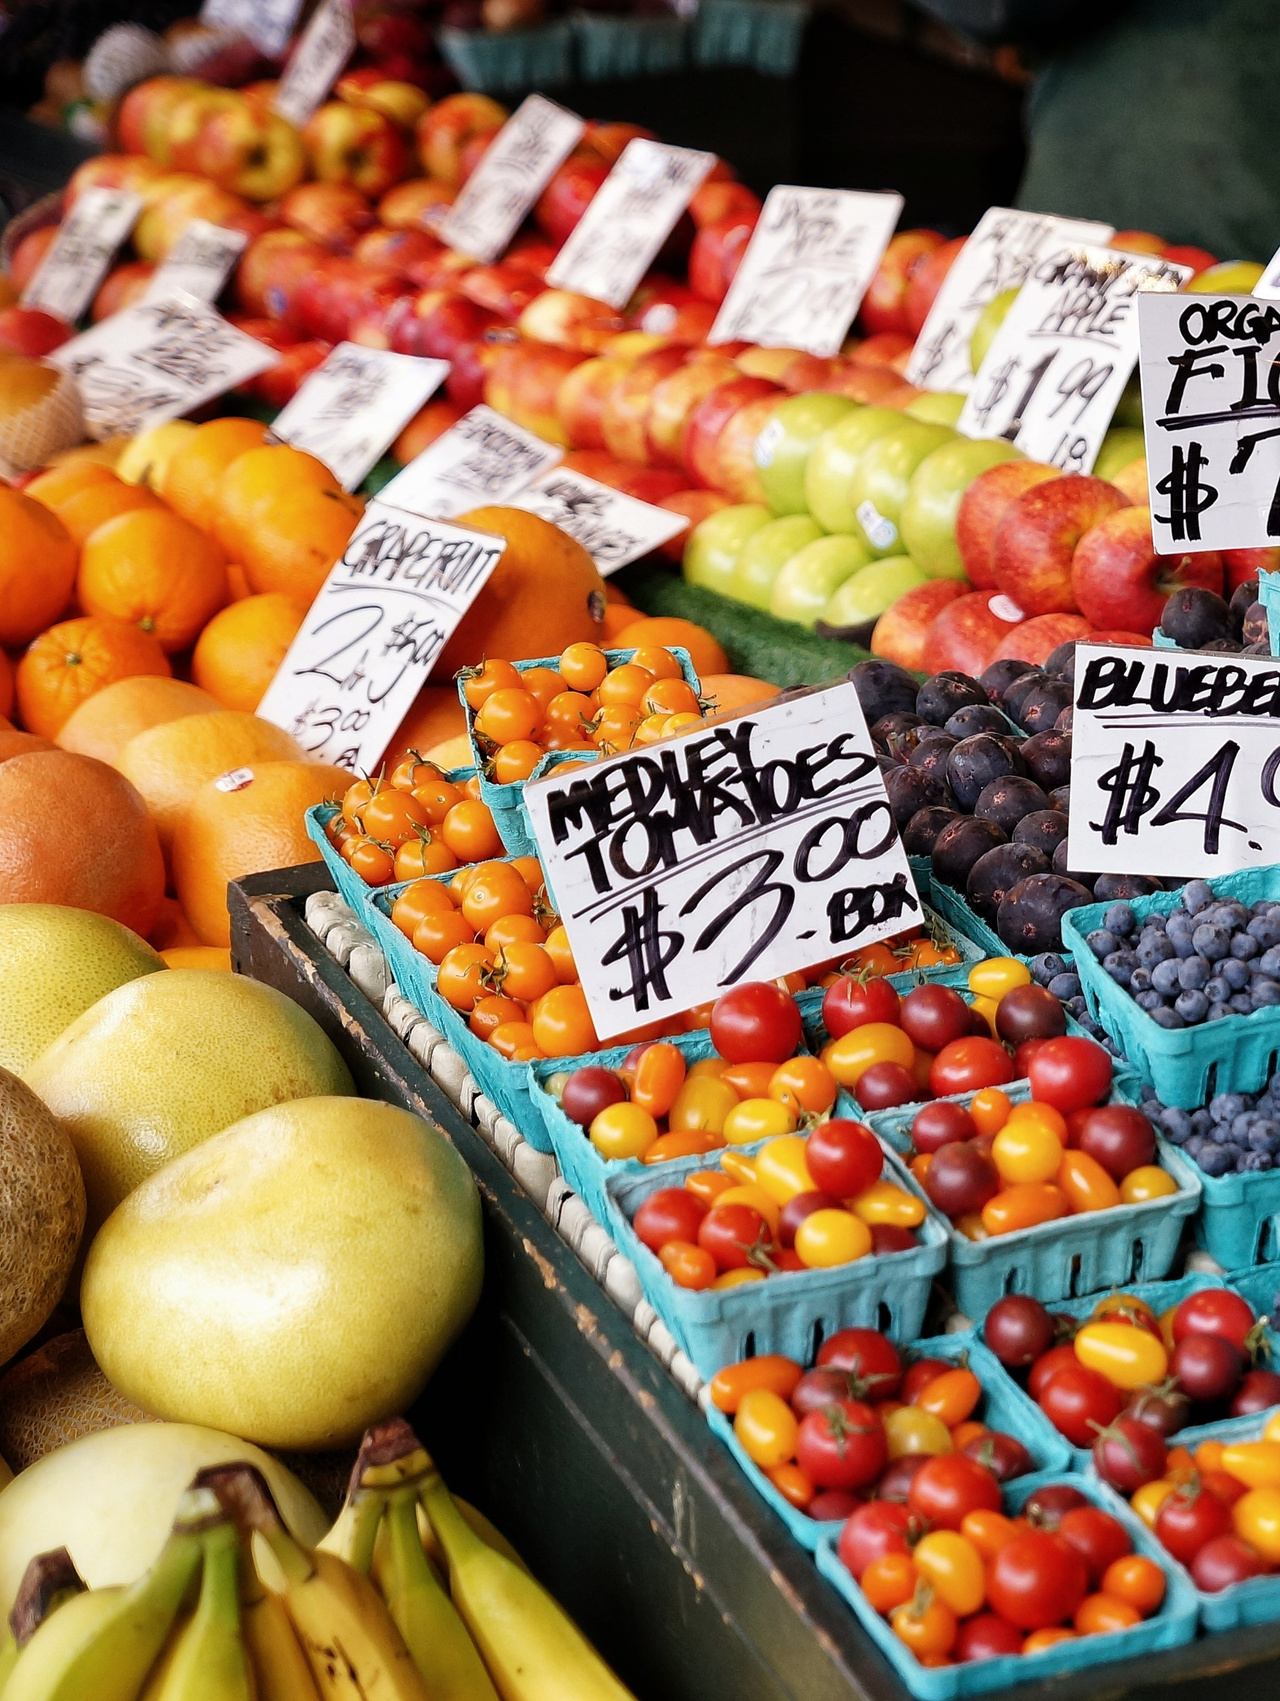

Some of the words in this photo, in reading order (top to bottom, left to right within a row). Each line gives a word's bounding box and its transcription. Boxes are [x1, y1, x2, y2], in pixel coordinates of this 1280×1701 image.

[1038, 290, 1130, 335] APPLE
[343, 520, 502, 594] GRAPEFRUIT
[293, 605, 384, 685] 2
[547, 721, 758, 846] MEDLEY
[564, 733, 879, 893] TOMATOES
[827, 872, 918, 944] BOX
